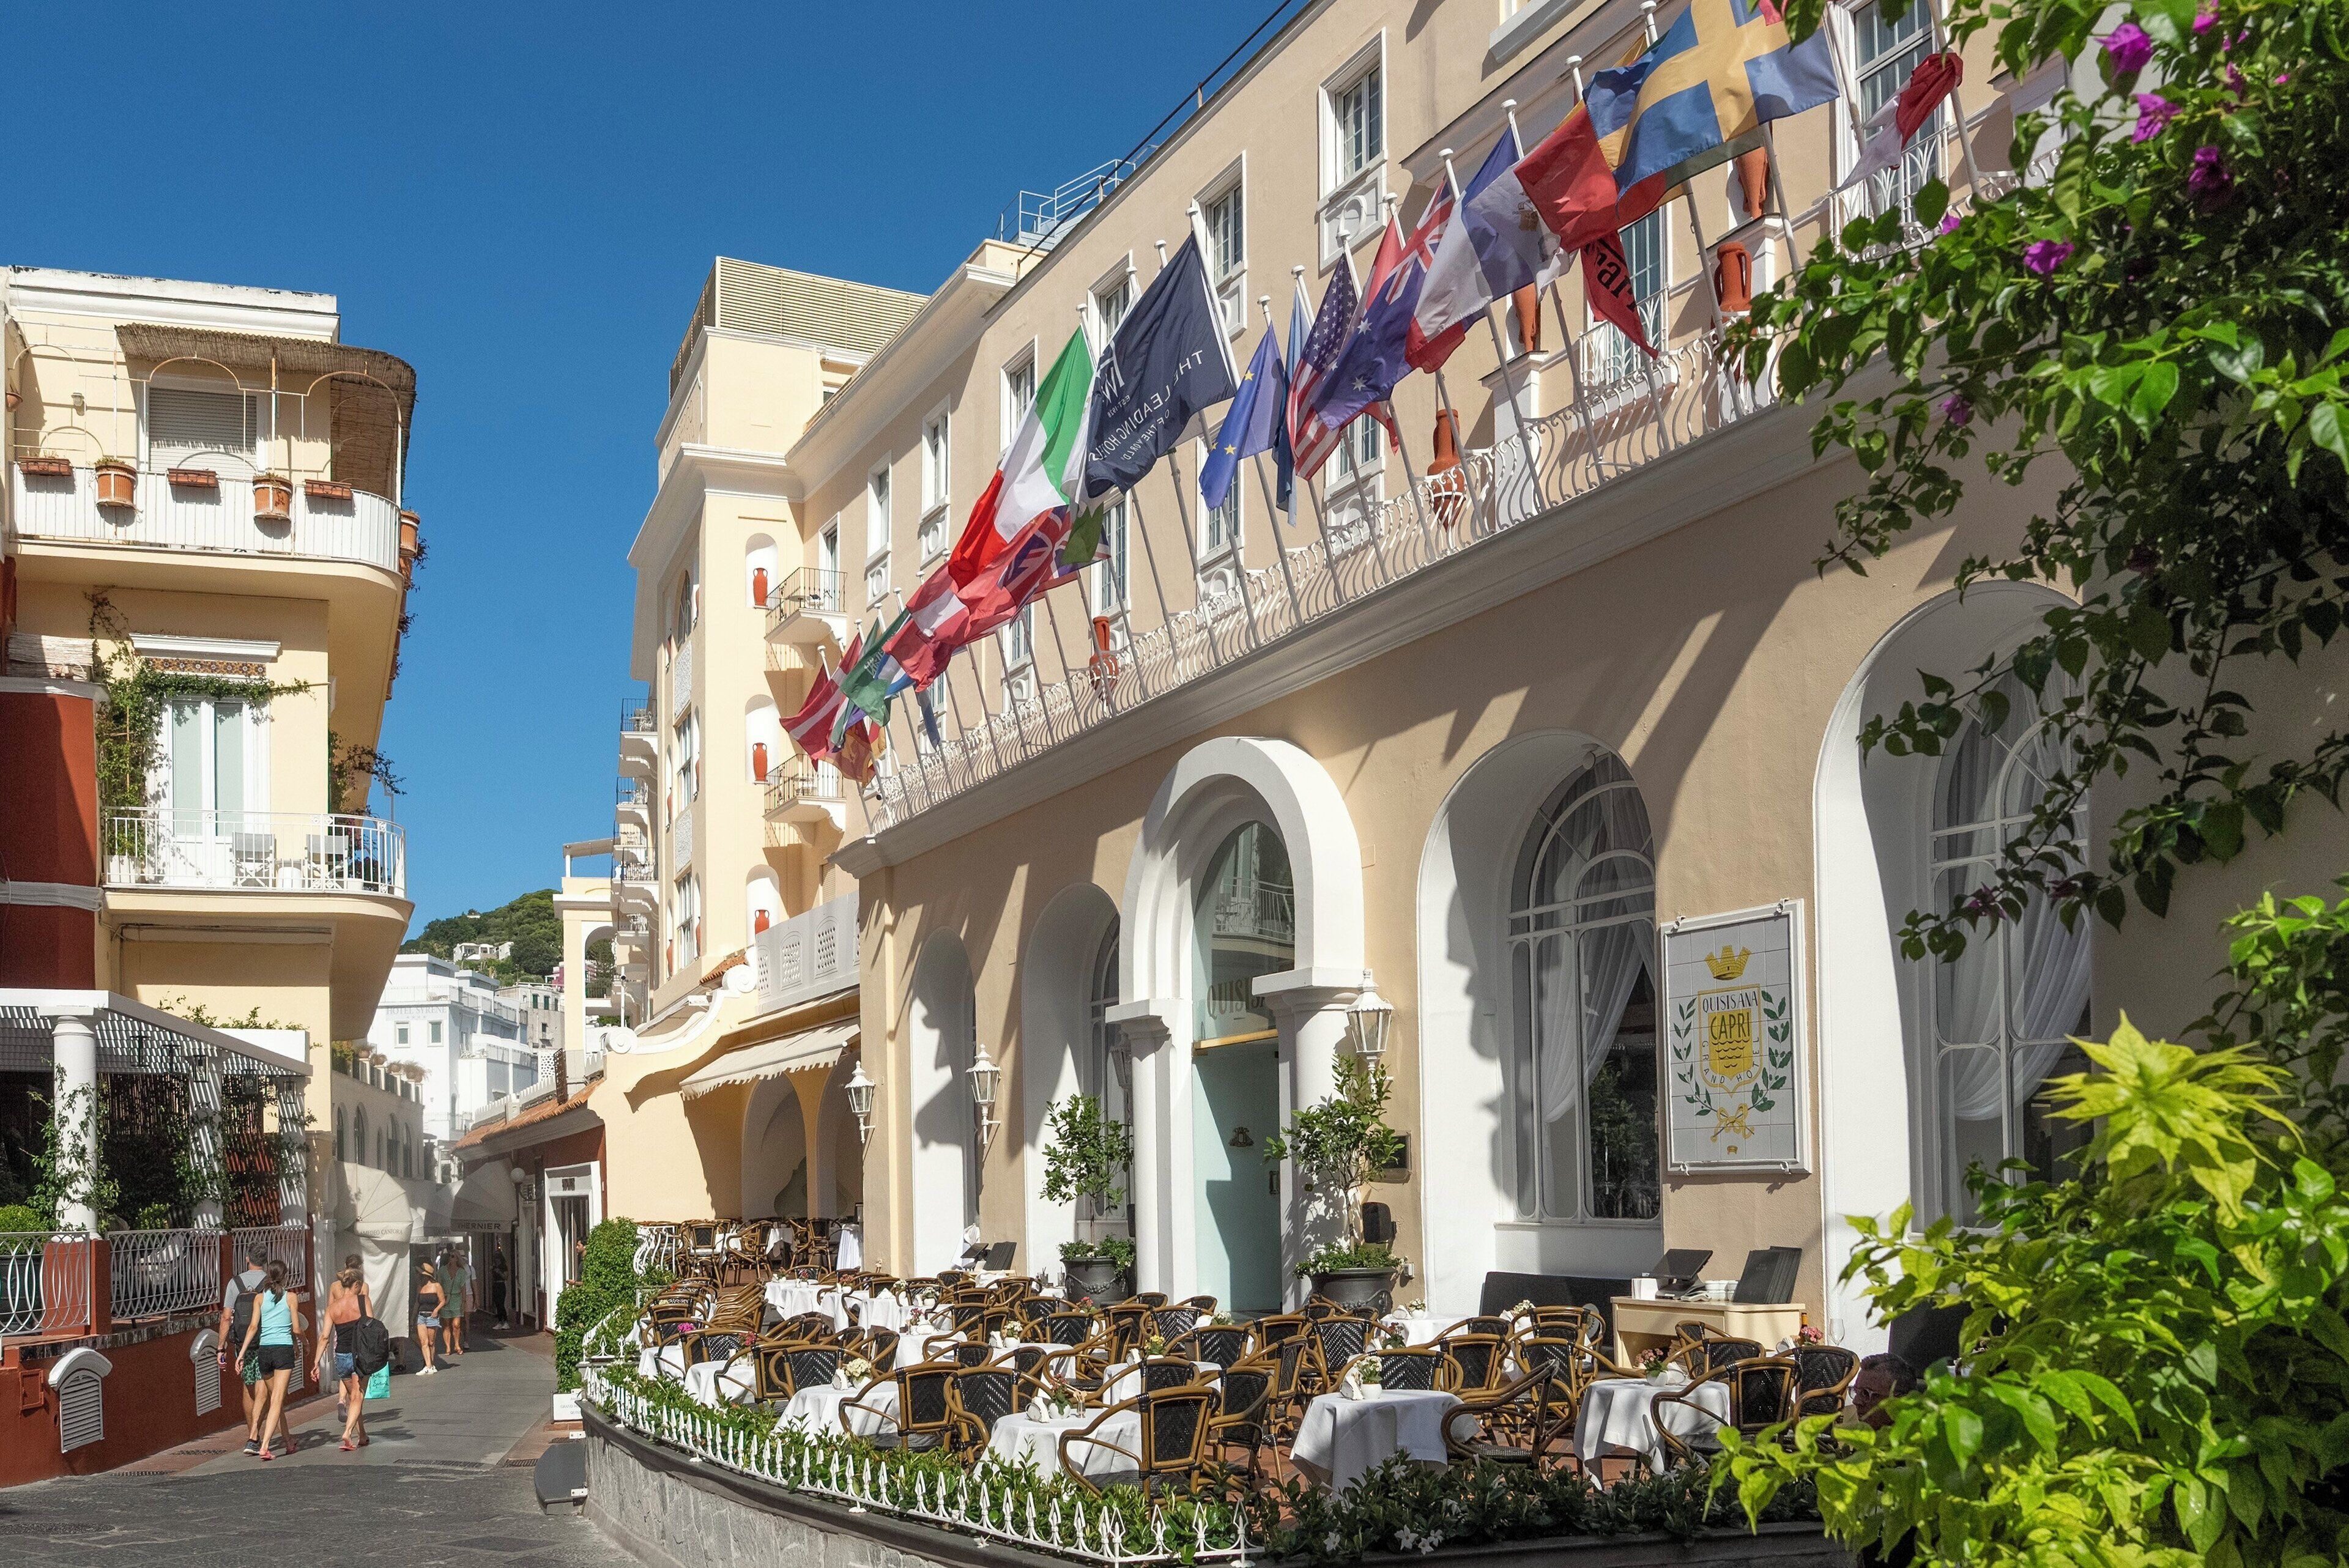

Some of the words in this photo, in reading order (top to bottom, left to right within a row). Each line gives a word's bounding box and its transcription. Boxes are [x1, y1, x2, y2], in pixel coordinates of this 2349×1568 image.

[1702, 991, 1758, 1013] QUISISANA
[1710, 1012, 1750, 1040] CAPRI
[1702, 1040, 1725, 1084] GRAND
[1737, 1037, 1759, 1082] HOTEL
